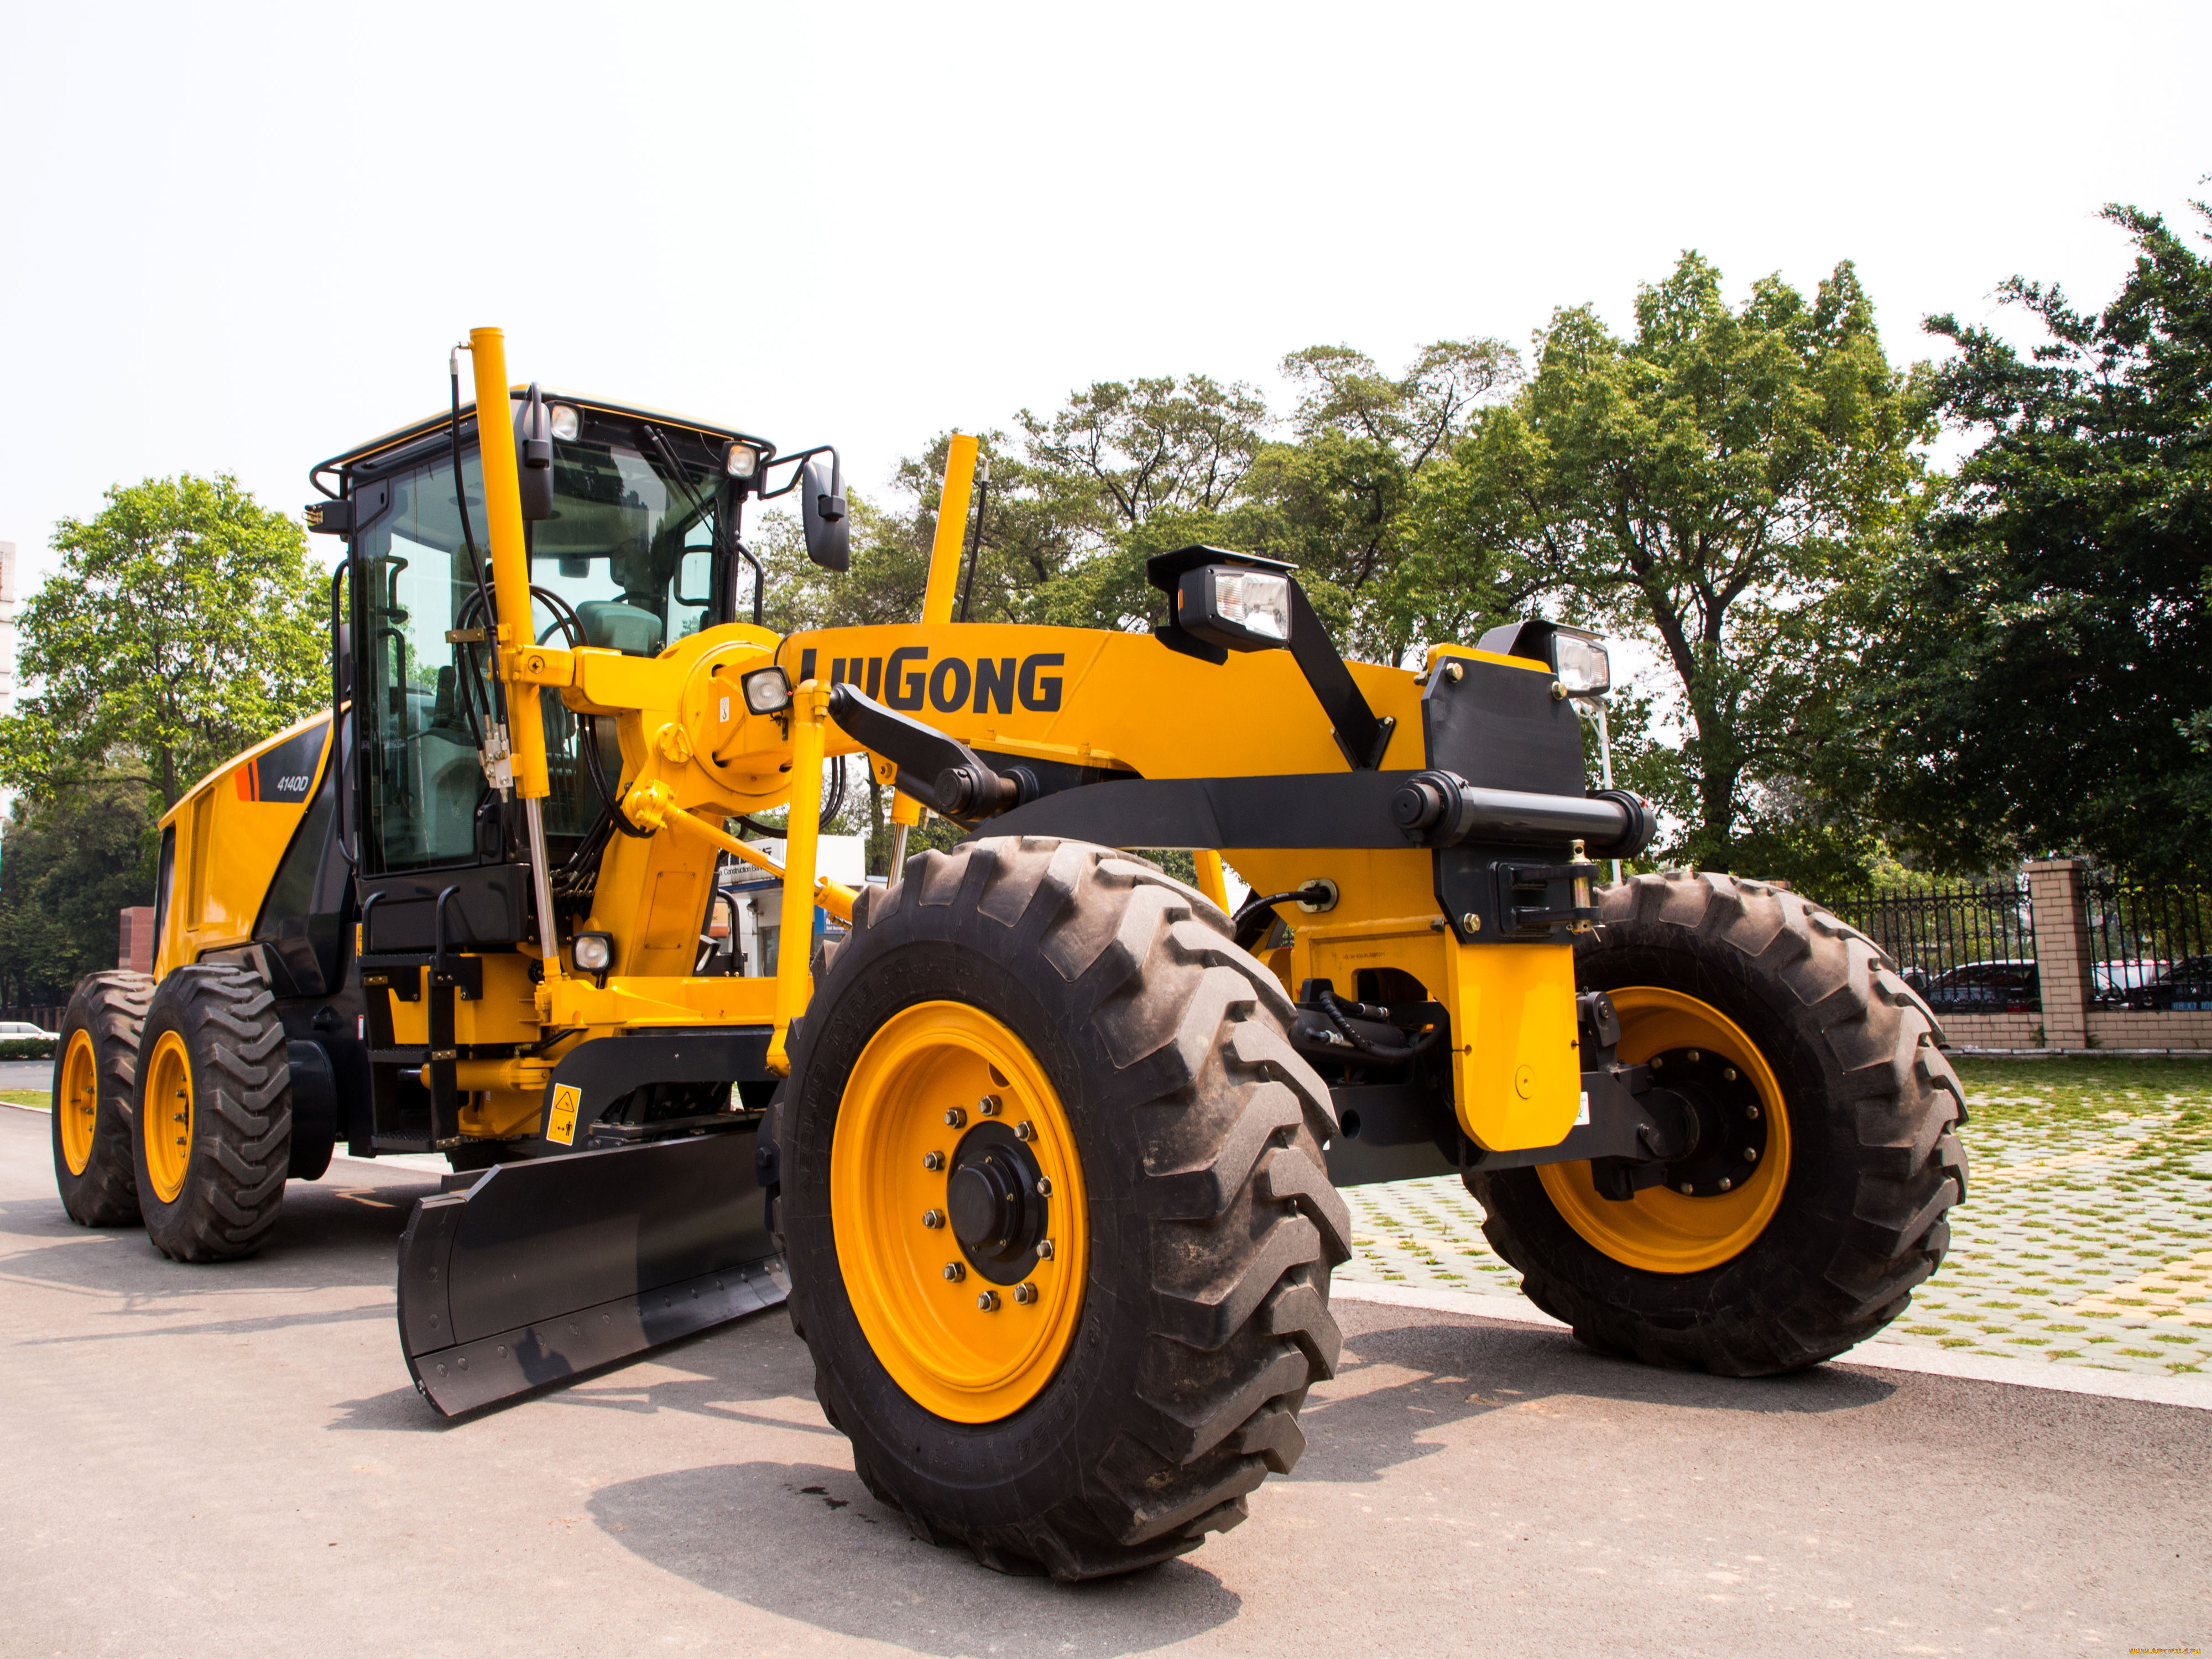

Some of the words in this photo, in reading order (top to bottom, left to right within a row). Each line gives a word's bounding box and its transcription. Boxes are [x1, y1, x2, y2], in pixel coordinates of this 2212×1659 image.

[277, 776, 309, 791] 4140D
[723, 866, 751, 875] Construction
[800, 1062, 827, 1202] AEOLUS
